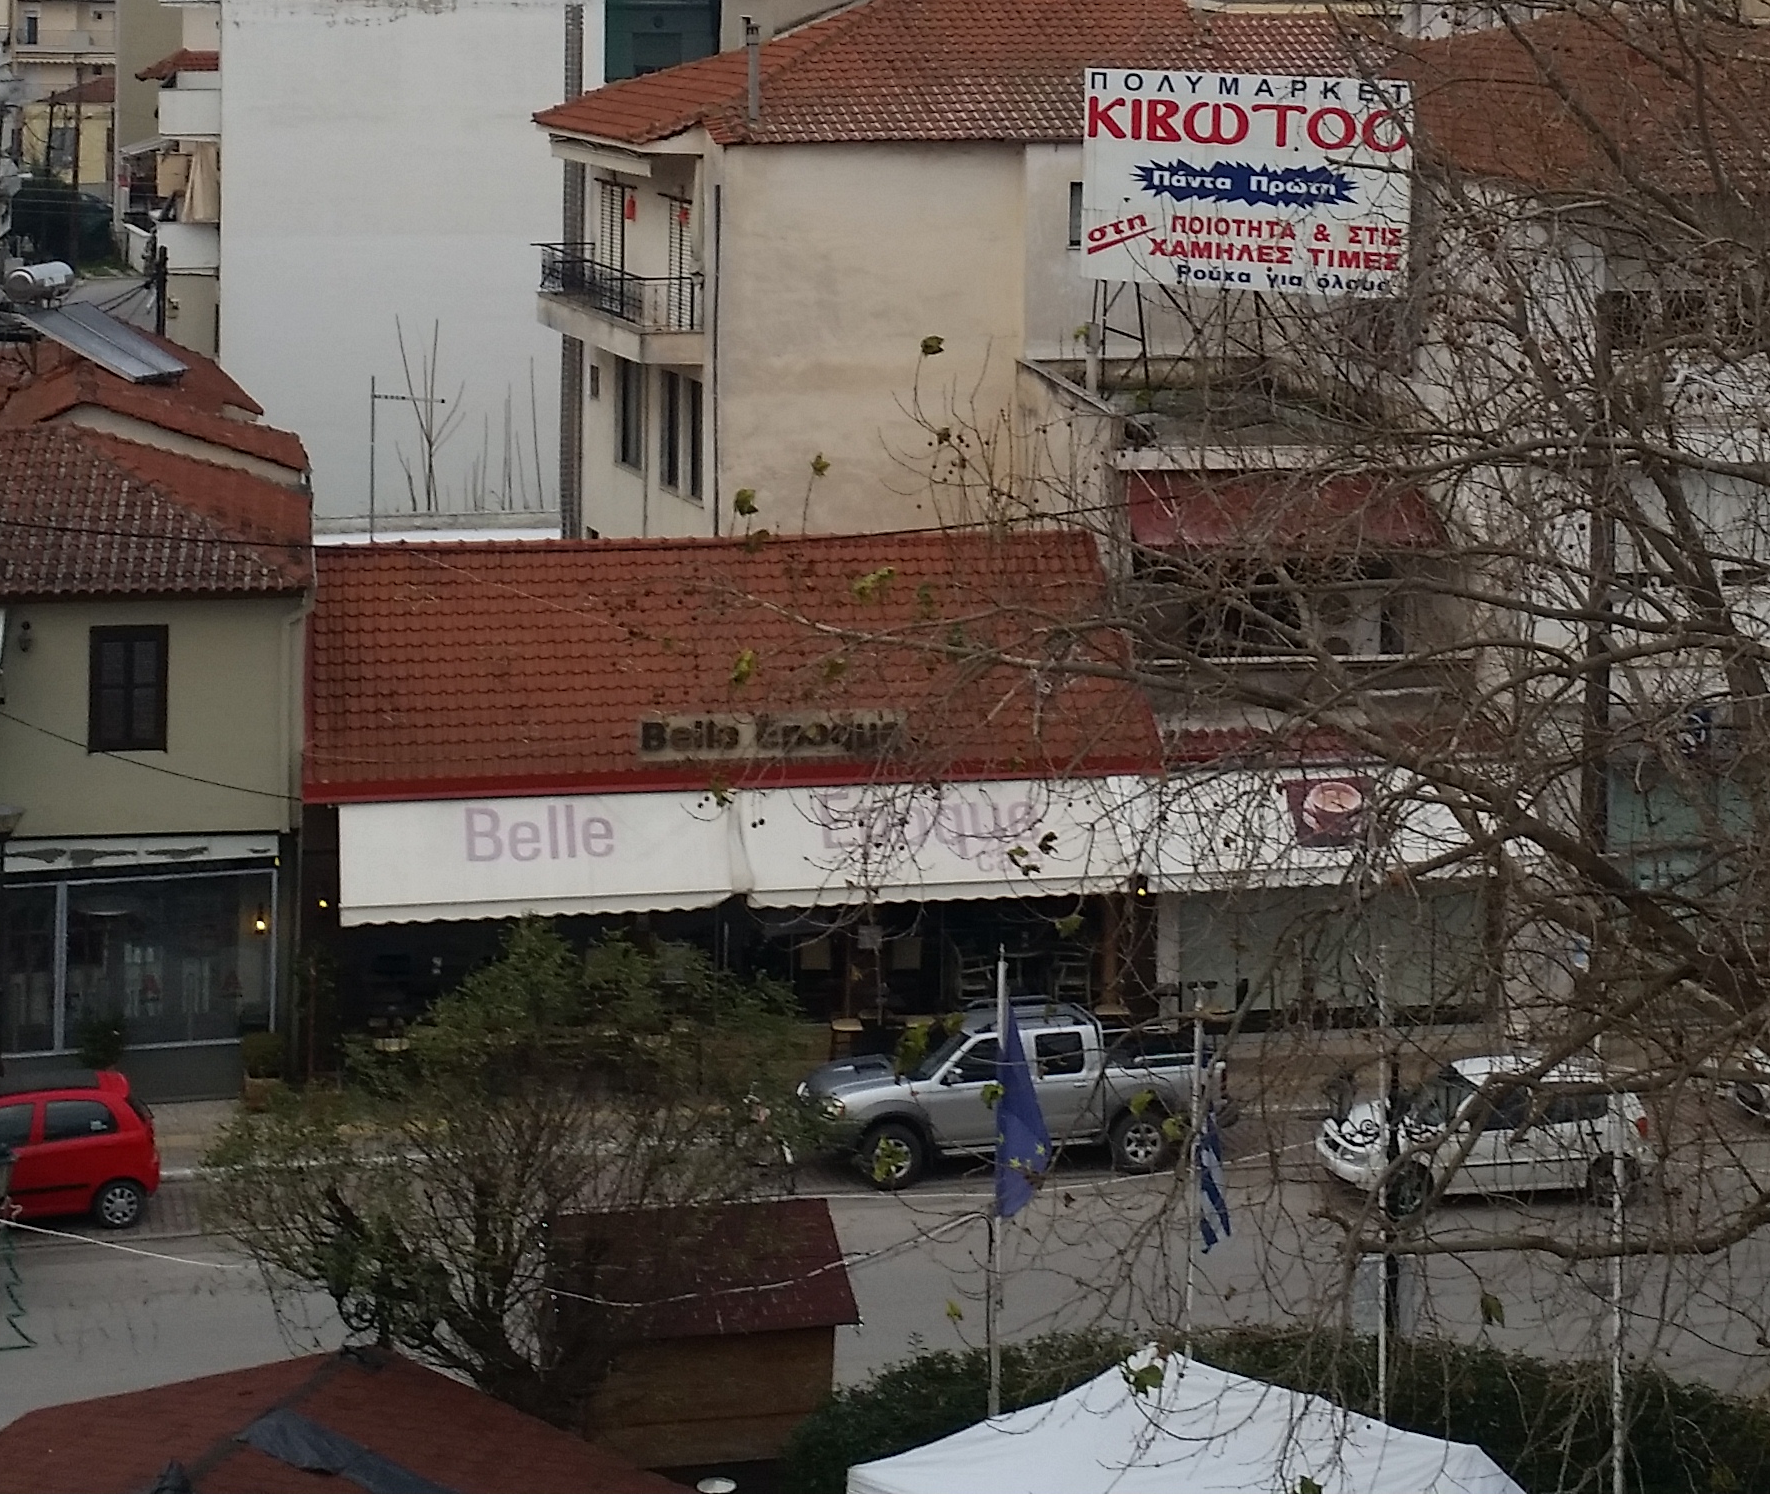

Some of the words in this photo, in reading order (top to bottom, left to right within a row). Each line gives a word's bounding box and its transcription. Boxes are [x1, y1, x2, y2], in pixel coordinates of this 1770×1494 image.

[1089, 71, 1408, 103] ΠΟΛΥΜΑΡΚΕΤ
[1152, 169, 1233, 191] Πάντα
[1249, 175, 1337, 197] Πρώτη
[1087, 214, 1149, 244] στη
[1171, 215, 1297, 241] ΠΟΙΟΤΗΤΑ
[1313, 222, 1331, 243] &
[1348, 225, 1403, 247] ΣΤΙΣ
[1148, 237, 1293, 265] ΧΑΜΗΛΕΣ
[1307, 247, 1401, 272] ΤΙΜΕΣ
[464, 805, 615, 862] Belle
